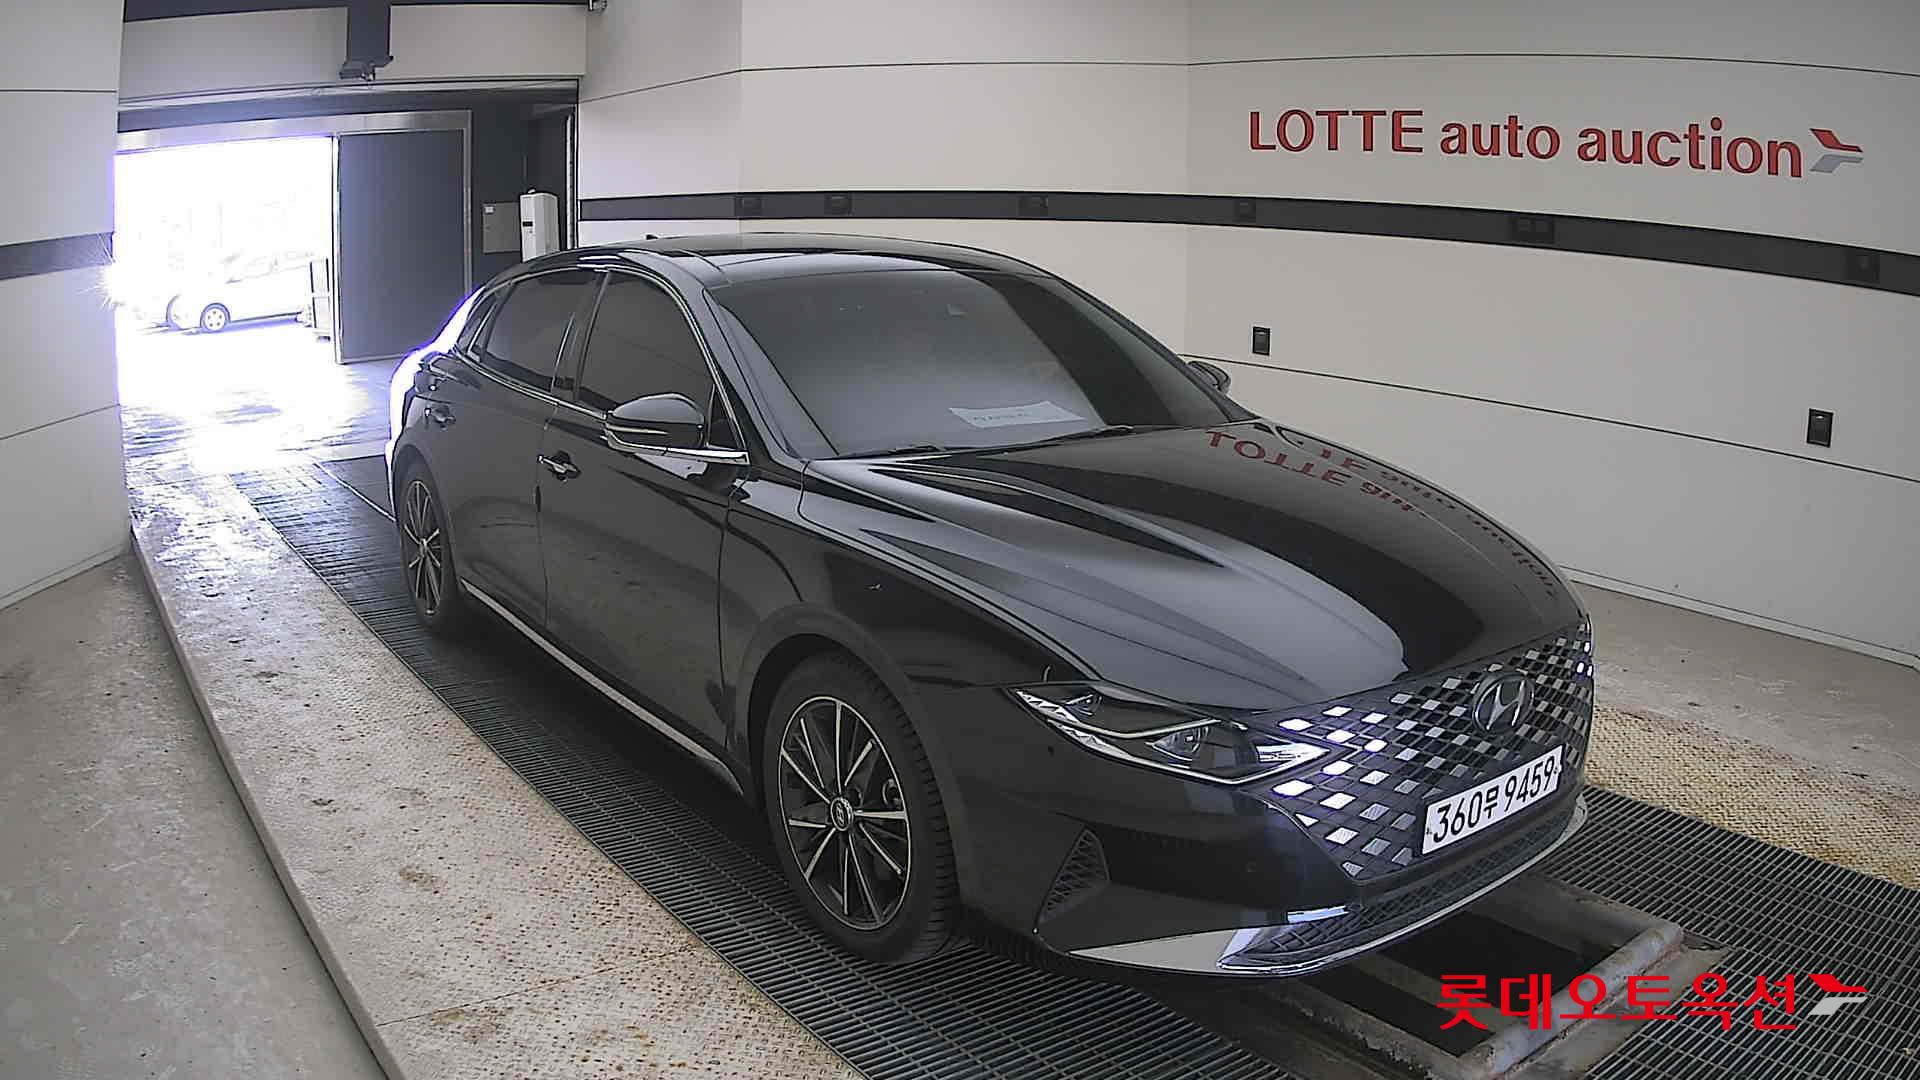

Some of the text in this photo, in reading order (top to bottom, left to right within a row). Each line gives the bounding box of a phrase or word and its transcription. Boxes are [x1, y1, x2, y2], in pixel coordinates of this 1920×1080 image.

[1249, 110, 1804, 178] LOTTE auto auction
[1504, 755, 1556, 812] 9459
